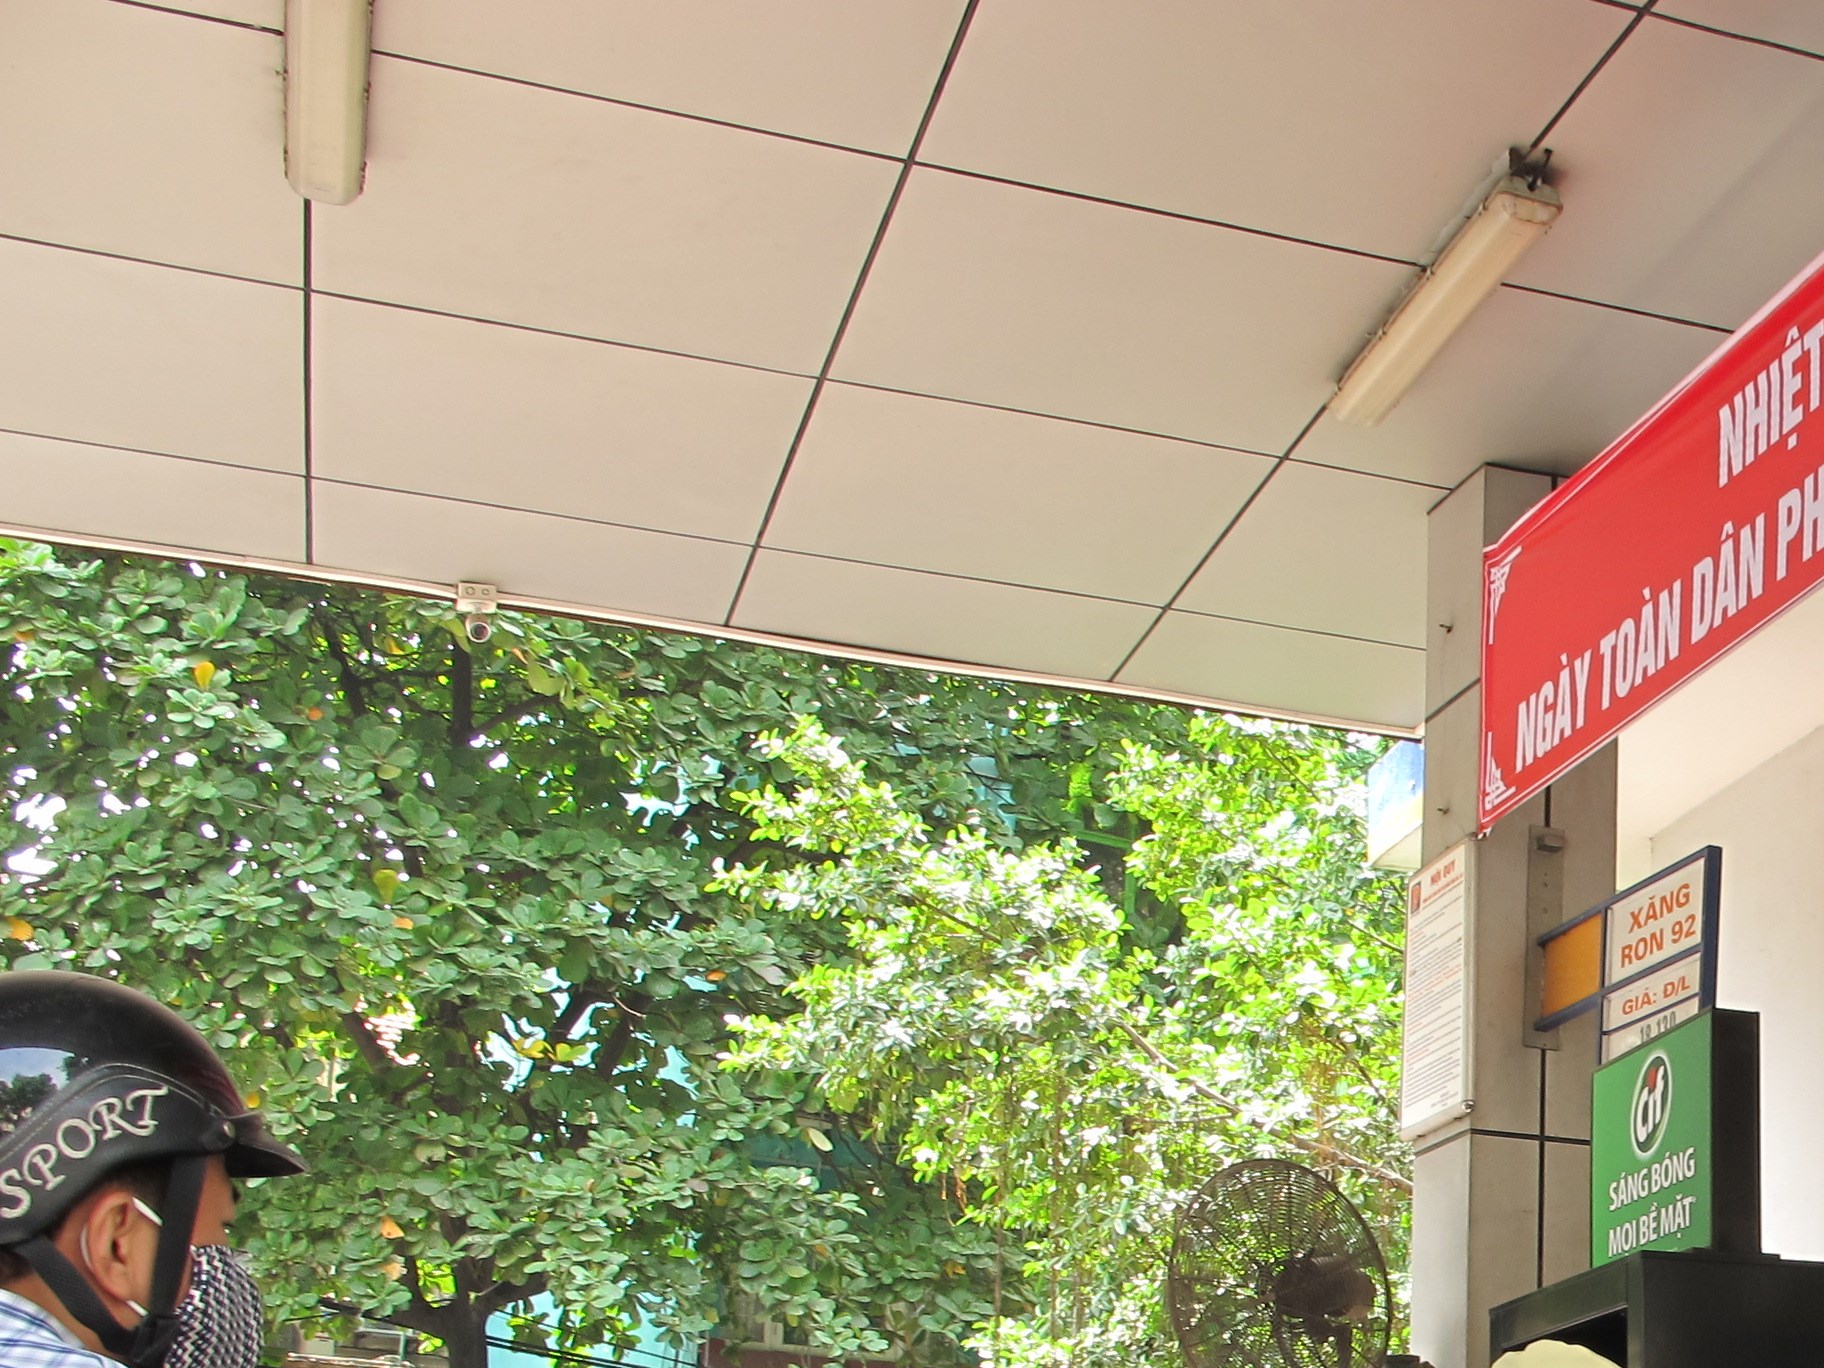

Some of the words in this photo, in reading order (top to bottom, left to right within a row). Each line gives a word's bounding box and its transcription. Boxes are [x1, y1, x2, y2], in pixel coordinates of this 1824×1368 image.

[1514, 649, 1591, 773] NGÀY
[1600, 579, 1682, 710] TOÀN
[1691, 512, 1766, 646] DÂN
[1629, 883, 1691, 934] XĂNG
[1621, 928, 1663, 968] RON
[1671, 914, 1696, 944] 92
[1622, 988, 1657, 1015] GIÁ:
[0, 1084, 169, 1218] SPORT
[1609, 1168, 1649, 1212] SÁNG
[1651, 1147, 1696, 1194] BÓNG
[1609, 1218, 1637, 1257] MỌI
[1639, 1202, 1657, 1245] BỀ
[1660, 1193, 1694, 1239] MẶT
